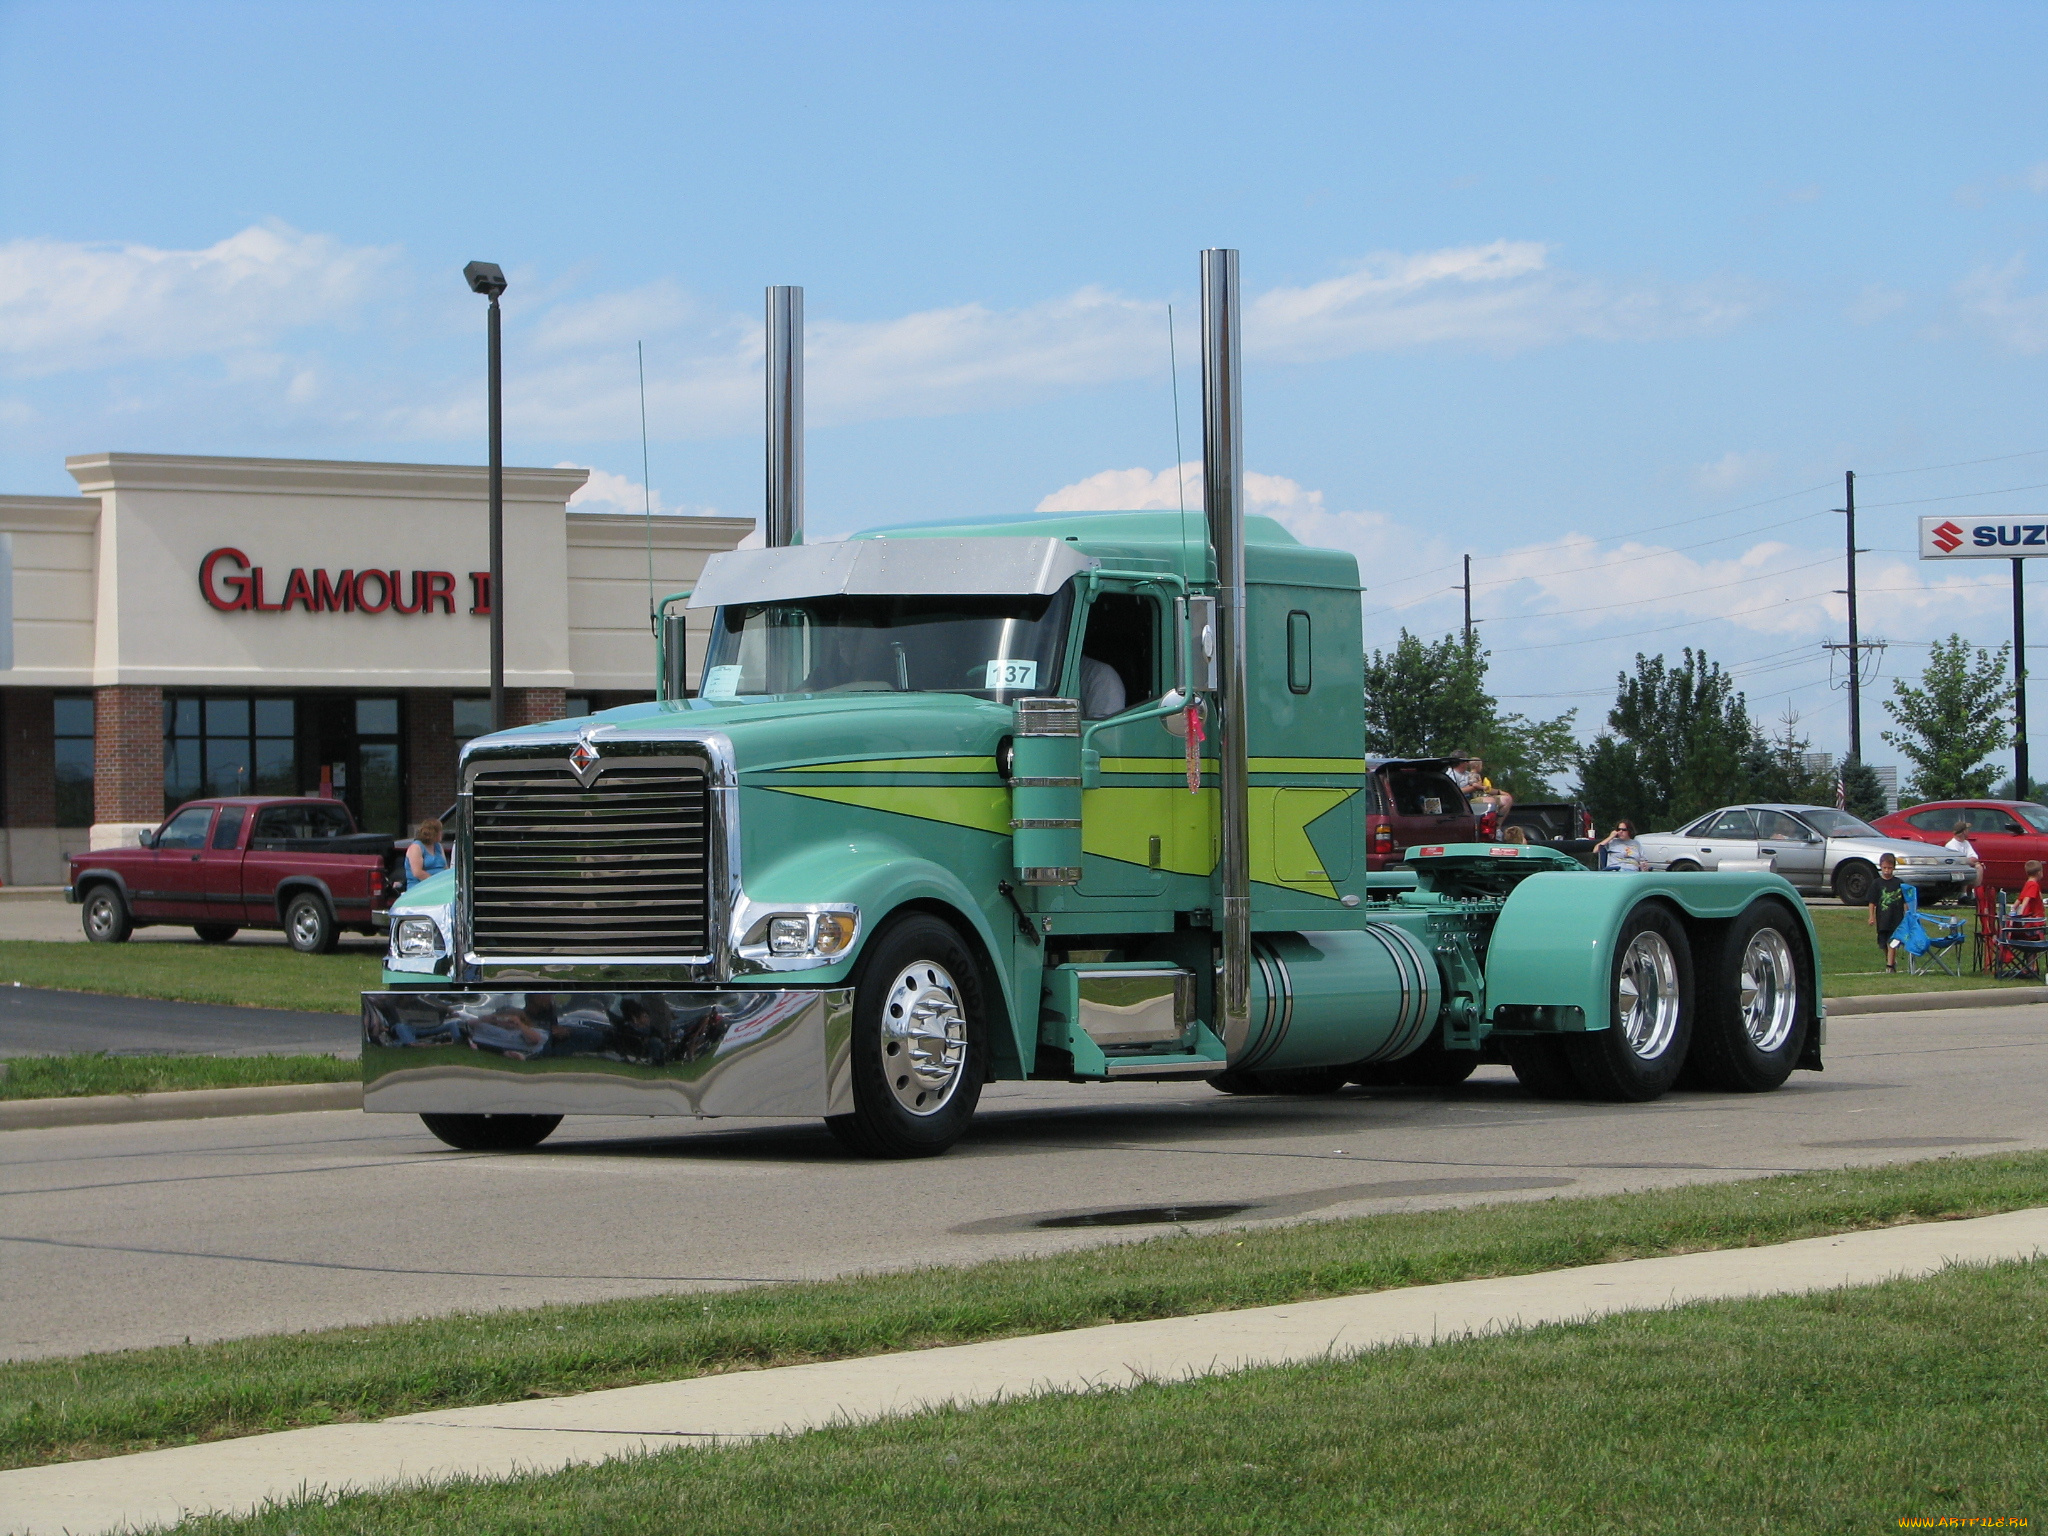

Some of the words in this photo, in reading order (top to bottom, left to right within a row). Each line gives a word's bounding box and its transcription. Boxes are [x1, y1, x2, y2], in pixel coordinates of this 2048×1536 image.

[1973, 525, 2048, 547] SUZ
[199, 547, 456, 614] GLAMOUR
[992, 665, 1031, 683] 137
